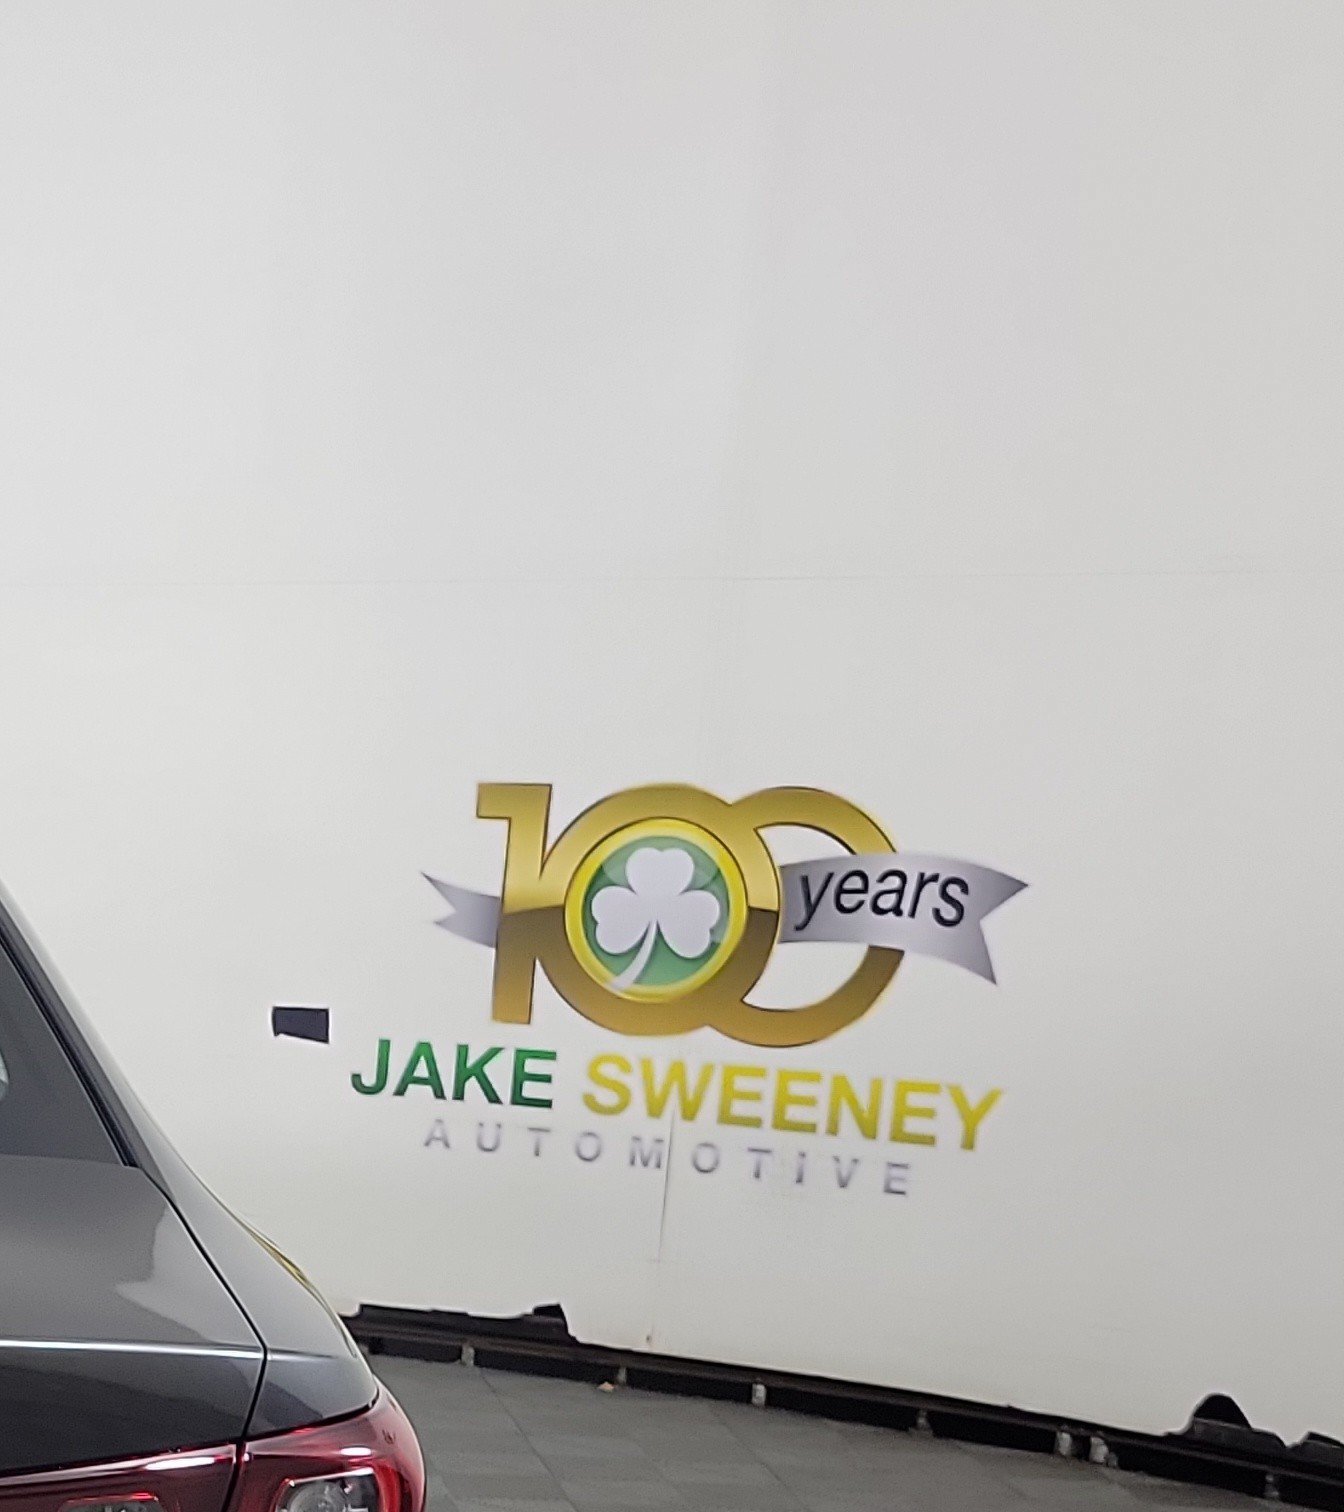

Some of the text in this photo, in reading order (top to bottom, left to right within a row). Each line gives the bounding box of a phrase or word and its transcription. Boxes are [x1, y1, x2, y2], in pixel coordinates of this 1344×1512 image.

[476, 782, 969, 1048] 100 years
[350, 1038, 1004, 1152] JAKE SWEENEY
[423, 1119, 912, 1198] AUTOMOTIVE
